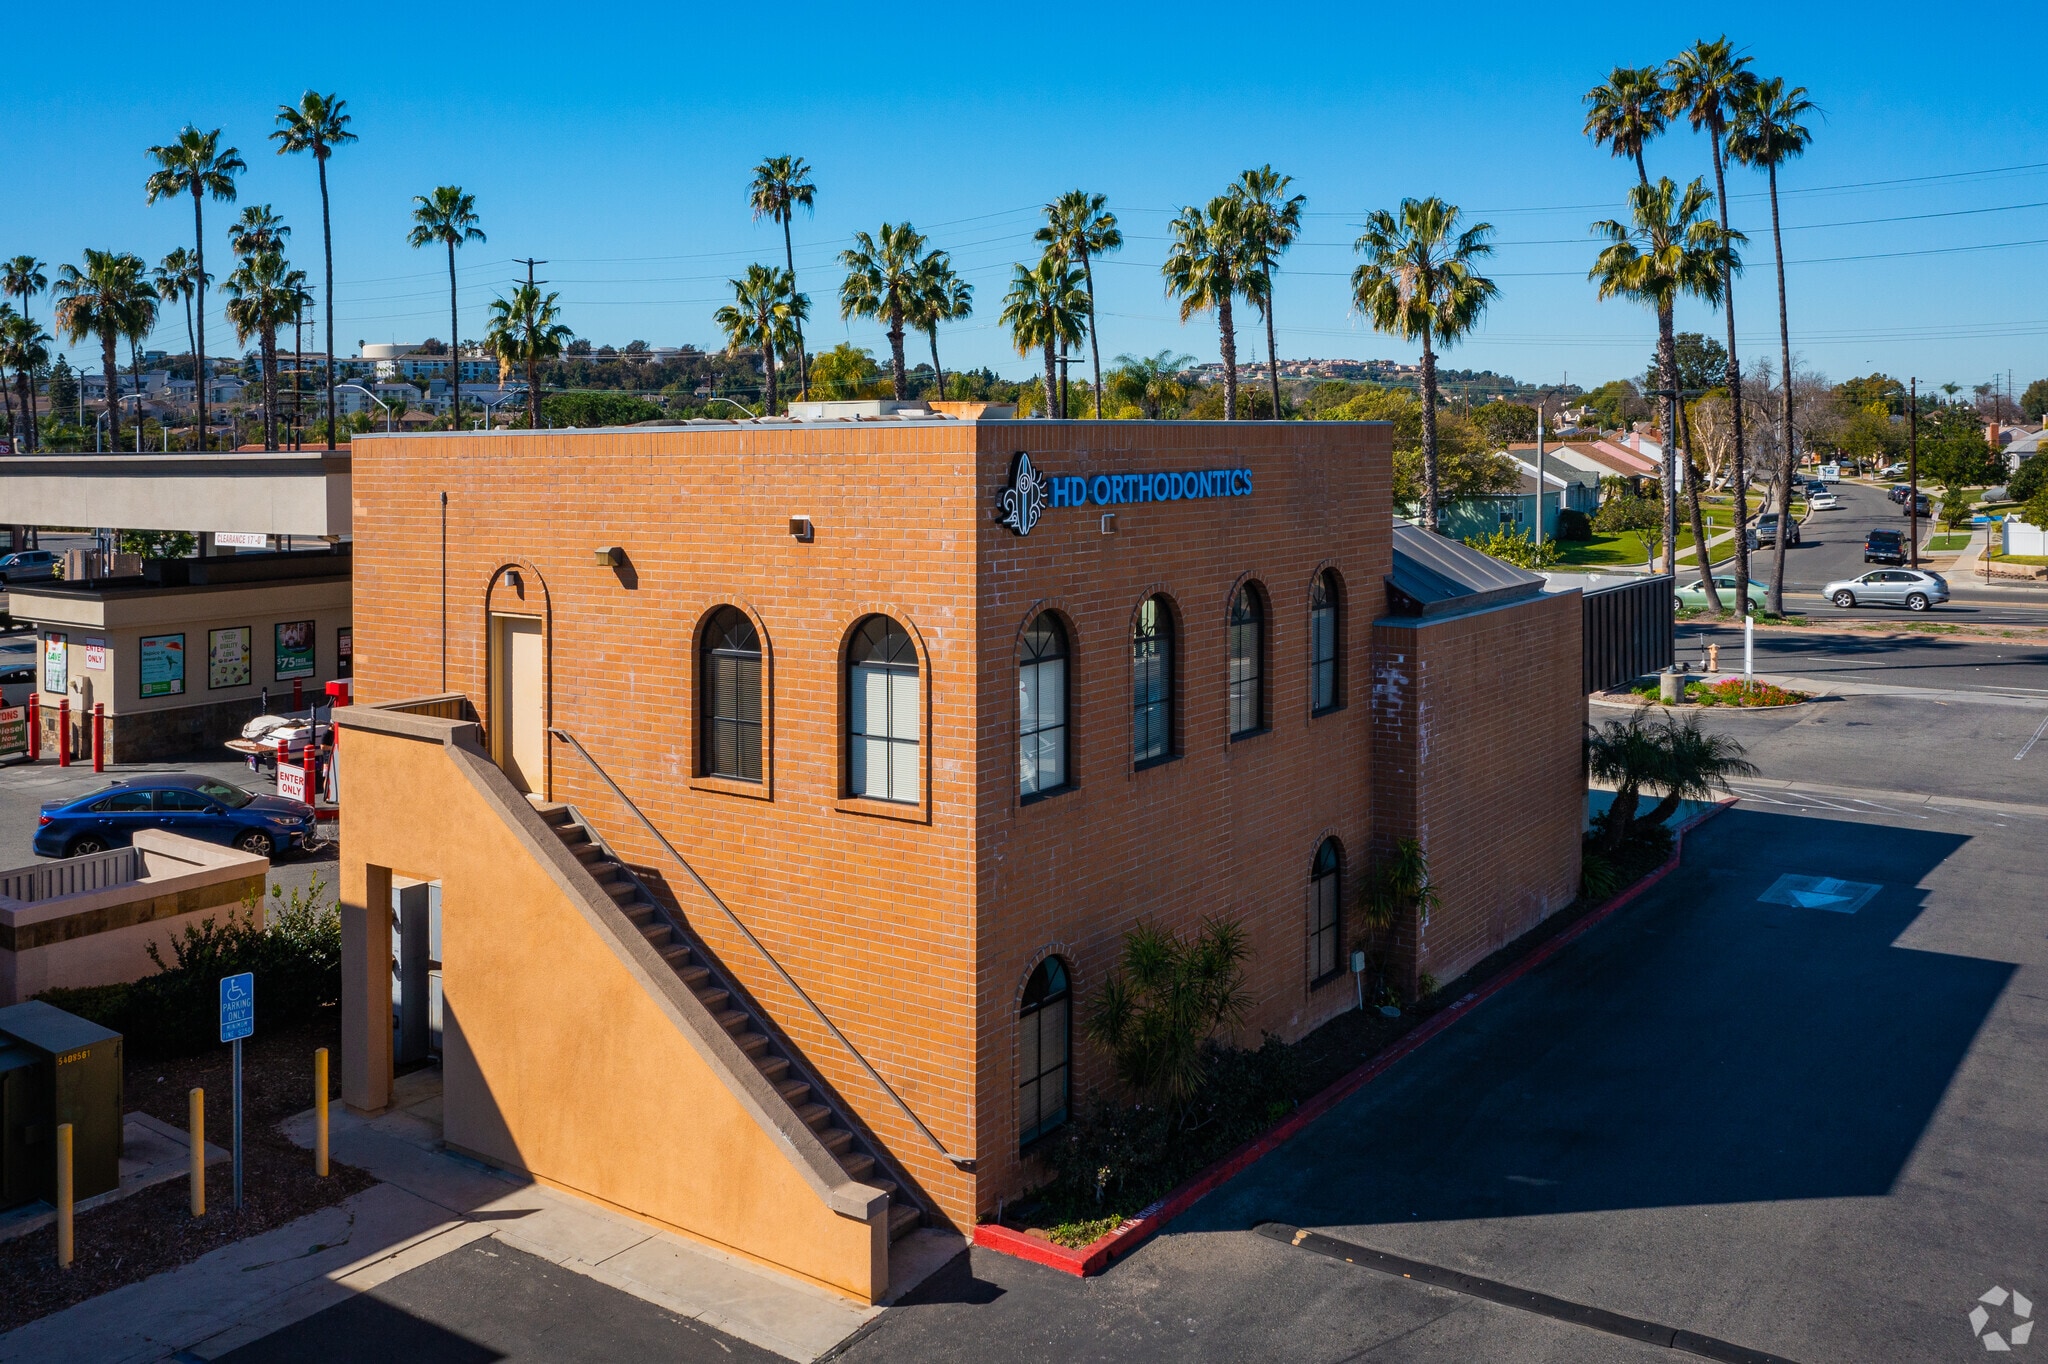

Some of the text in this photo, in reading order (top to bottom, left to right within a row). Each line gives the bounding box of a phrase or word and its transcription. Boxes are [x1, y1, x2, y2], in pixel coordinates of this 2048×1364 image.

[1053, 469, 1253, 507] HD ORTHODONTICS
[217, 534, 246, 544] CLEARANCE
[86, 644, 105, 653] ENTER
[48, 651, 62, 662] SAVE
[87, 654, 103, 664] ONLY
[277, 657, 296, 669] $75
[0, 710, 18, 721] ONS
[0, 723, 23, 735] iesel
[280, 771, 304, 786] ENTER
[282, 784, 301, 796] ONLY
[223, 998, 251, 1012] PARKING
[228, 1009, 246, 1022] ONLY
[227, 1021, 247, 1031] MINIMUM
[223, 1027, 251, 1039] FINE $250
